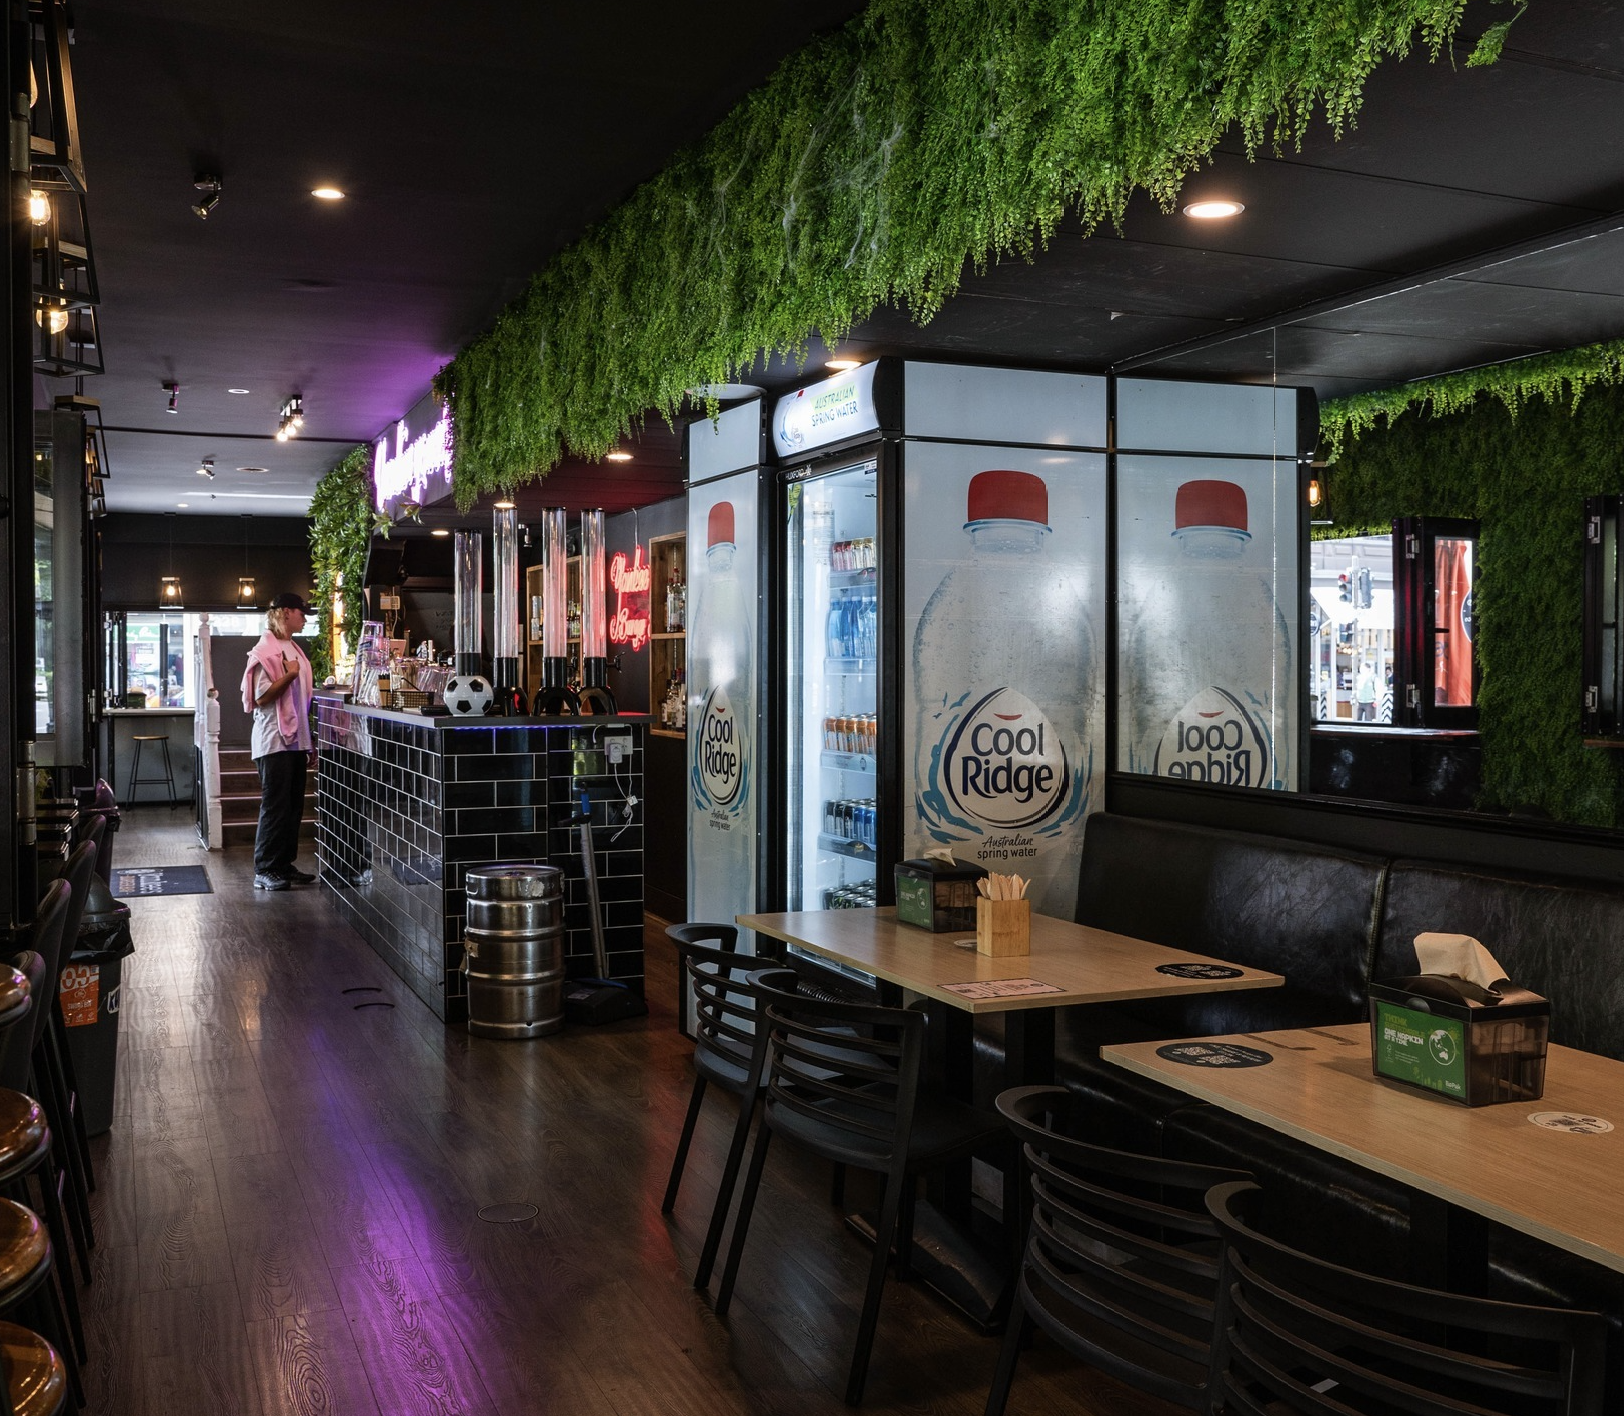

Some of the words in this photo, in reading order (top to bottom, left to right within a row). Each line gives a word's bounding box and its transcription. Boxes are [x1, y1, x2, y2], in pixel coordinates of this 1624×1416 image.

[815, 386, 855, 409] AUSTRALIAN
[812, 409, 835, 427] SPRING
[837, 401, 858, 417] WATER
[708, 713, 733, 745] Cool
[971, 722, 1045, 757] Cool
[704, 740, 737, 785] Ridge
[961, 755, 1054, 803] Ridge
[977, 847, 1009, 861] spring
[1010, 847, 1038, 857] water
[981, 833, 1034, 849] Australian
[1397, 1031, 1424, 1046] NAPKIN
